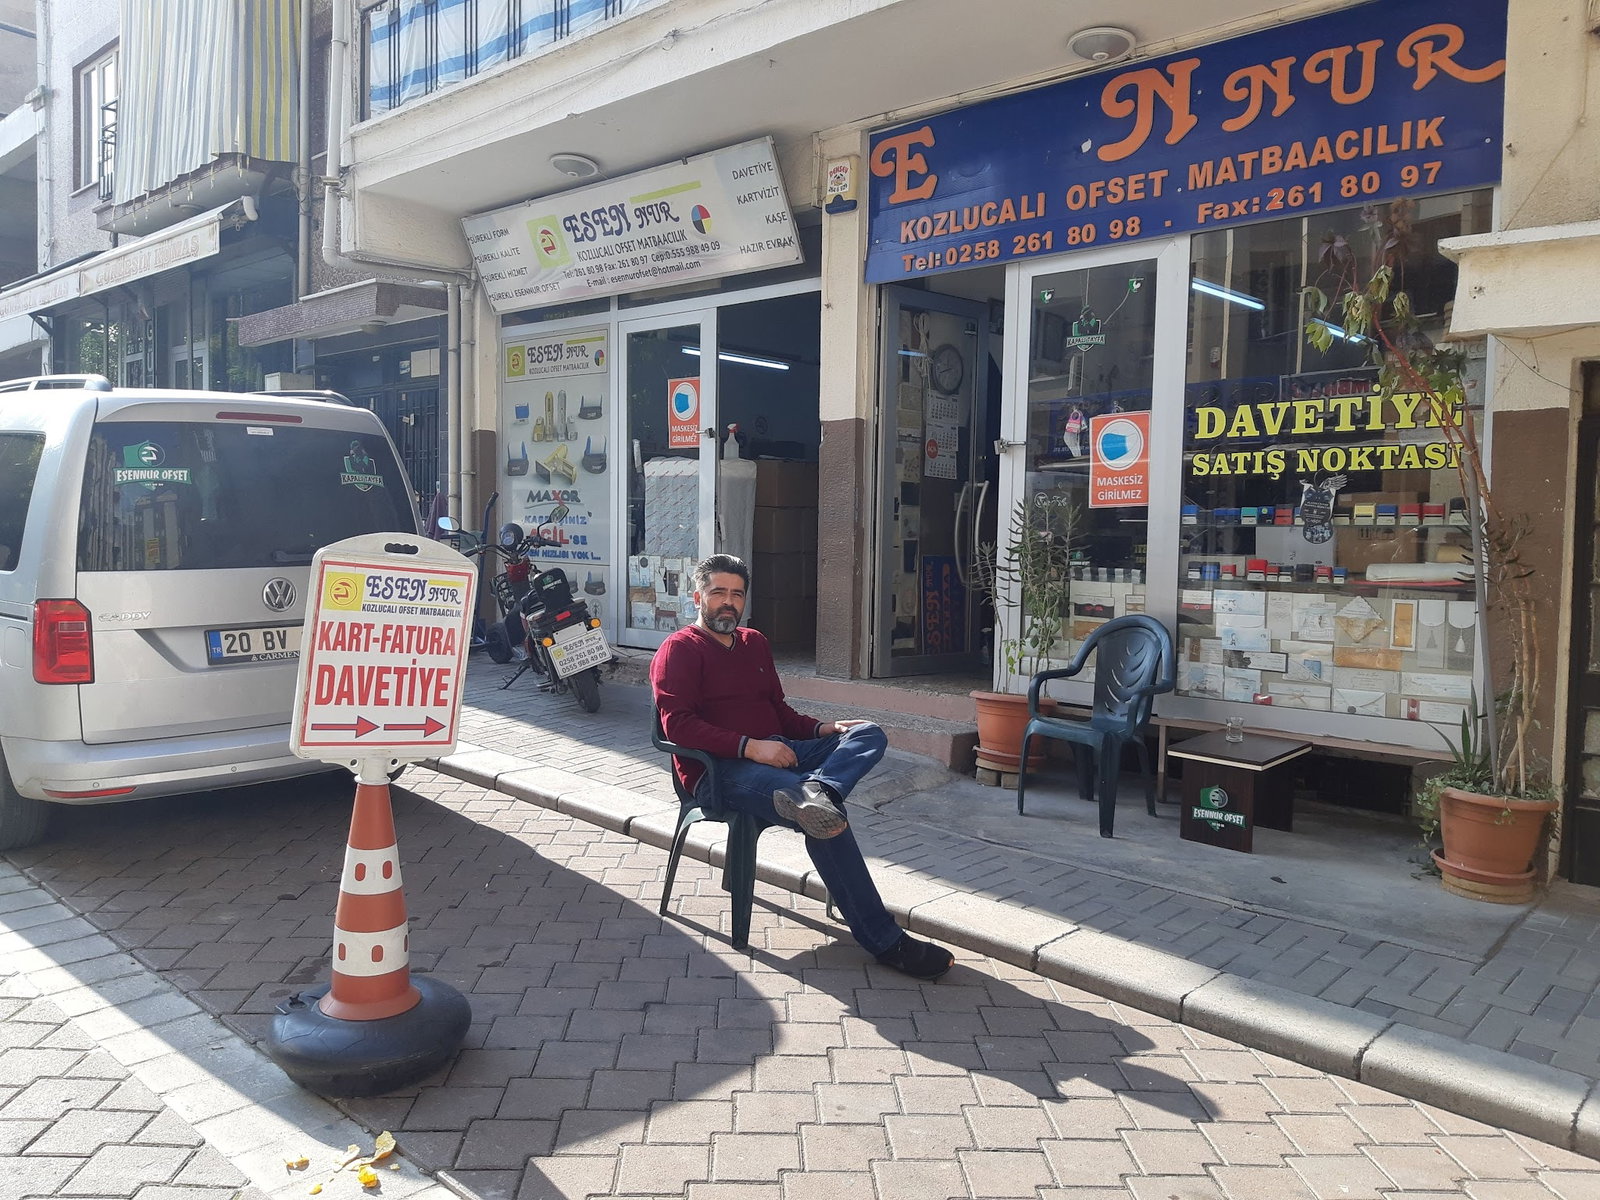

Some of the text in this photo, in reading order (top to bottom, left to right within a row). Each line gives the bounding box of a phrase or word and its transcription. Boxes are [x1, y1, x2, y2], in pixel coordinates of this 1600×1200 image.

[731, 161, 774, 181] DAVETİYE
[900, 117, 1446, 245] KOZLUCALI OFSET MATBAACILIK
[736, 186, 780, 206] KARTVİZİT
[1012, 230, 1053, 255] 261
[1066, 222, 1097, 246] 80
[1108, 216, 1141, 240] 98
[1339, 170, 1381, 198] 80
[1399, 160, 1444, 188] 97
[562, 201, 680, 244] ESEN NUR
[764, 210, 788, 225] KAŞE
[493, 228, 511, 239] FORM
[500, 246, 521, 258] KALİTE
[576, 228, 688, 263] KOZLUCALI OFSET MATBAACILIK
[739, 236, 796, 255] HAZIR EVRAK
[574, 266, 587, 278] 261
[587, 265, 595, 275] 80
[596, 263, 604, 274] 98
[617, 258, 631, 269] 261
[631, 256, 640, 266] 80
[640, 254, 649, 265] 97
[687, 245, 701, 256] 988
[701, 242, 710, 253] 49
[710, 240, 721, 251] 09
[507, 266, 529, 278] HİZMET
[610, 259, 702, 285] esennurofset@hotmail.com
[514, 285, 541, 298] ESENNUR
[542, 282, 561, 293] OFSET
[527, 343, 589, 364] ESEN NUR
[1194, 383, 1463, 440] DAVETİYE
[671, 424, 698, 433] MASKESİZ
[672, 433, 697, 443] GİRİLMEZ
[1192, 443, 1463, 480] SATIŞ NOKTASI
[116, 469, 188, 482] ESENNUR OFSET
[1096, 473, 1143, 487] MASKESİZ
[526, 489, 581, 504] MAXOR
[1097, 487, 1142, 501] GİRİLMEZ
[571, 551, 589, 560] YOK
[365, 575, 462, 605] ESEN NUR
[98, 611, 151, 622] CADDY
[361, 603, 462, 618] KOZLUCALI OFSET MATBAACILIK
[212, 630, 287, 654] TR 20 BV
[317, 620, 456, 656] KART-FATURA
[258, 651, 301, 662] CARMEN
[559, 656, 575, 667] 0258
[575, 651, 587, 660] 261
[586, 647, 596, 655] 80
[562, 662, 578, 674] 0555
[577, 658, 590, 667] 988
[598, 651, 607, 659] 09
[314, 658, 452, 708] DAVETİYE
[1193, 807, 1224, 821] ESENNUR
[1223, 812, 1245, 826] OFSET
